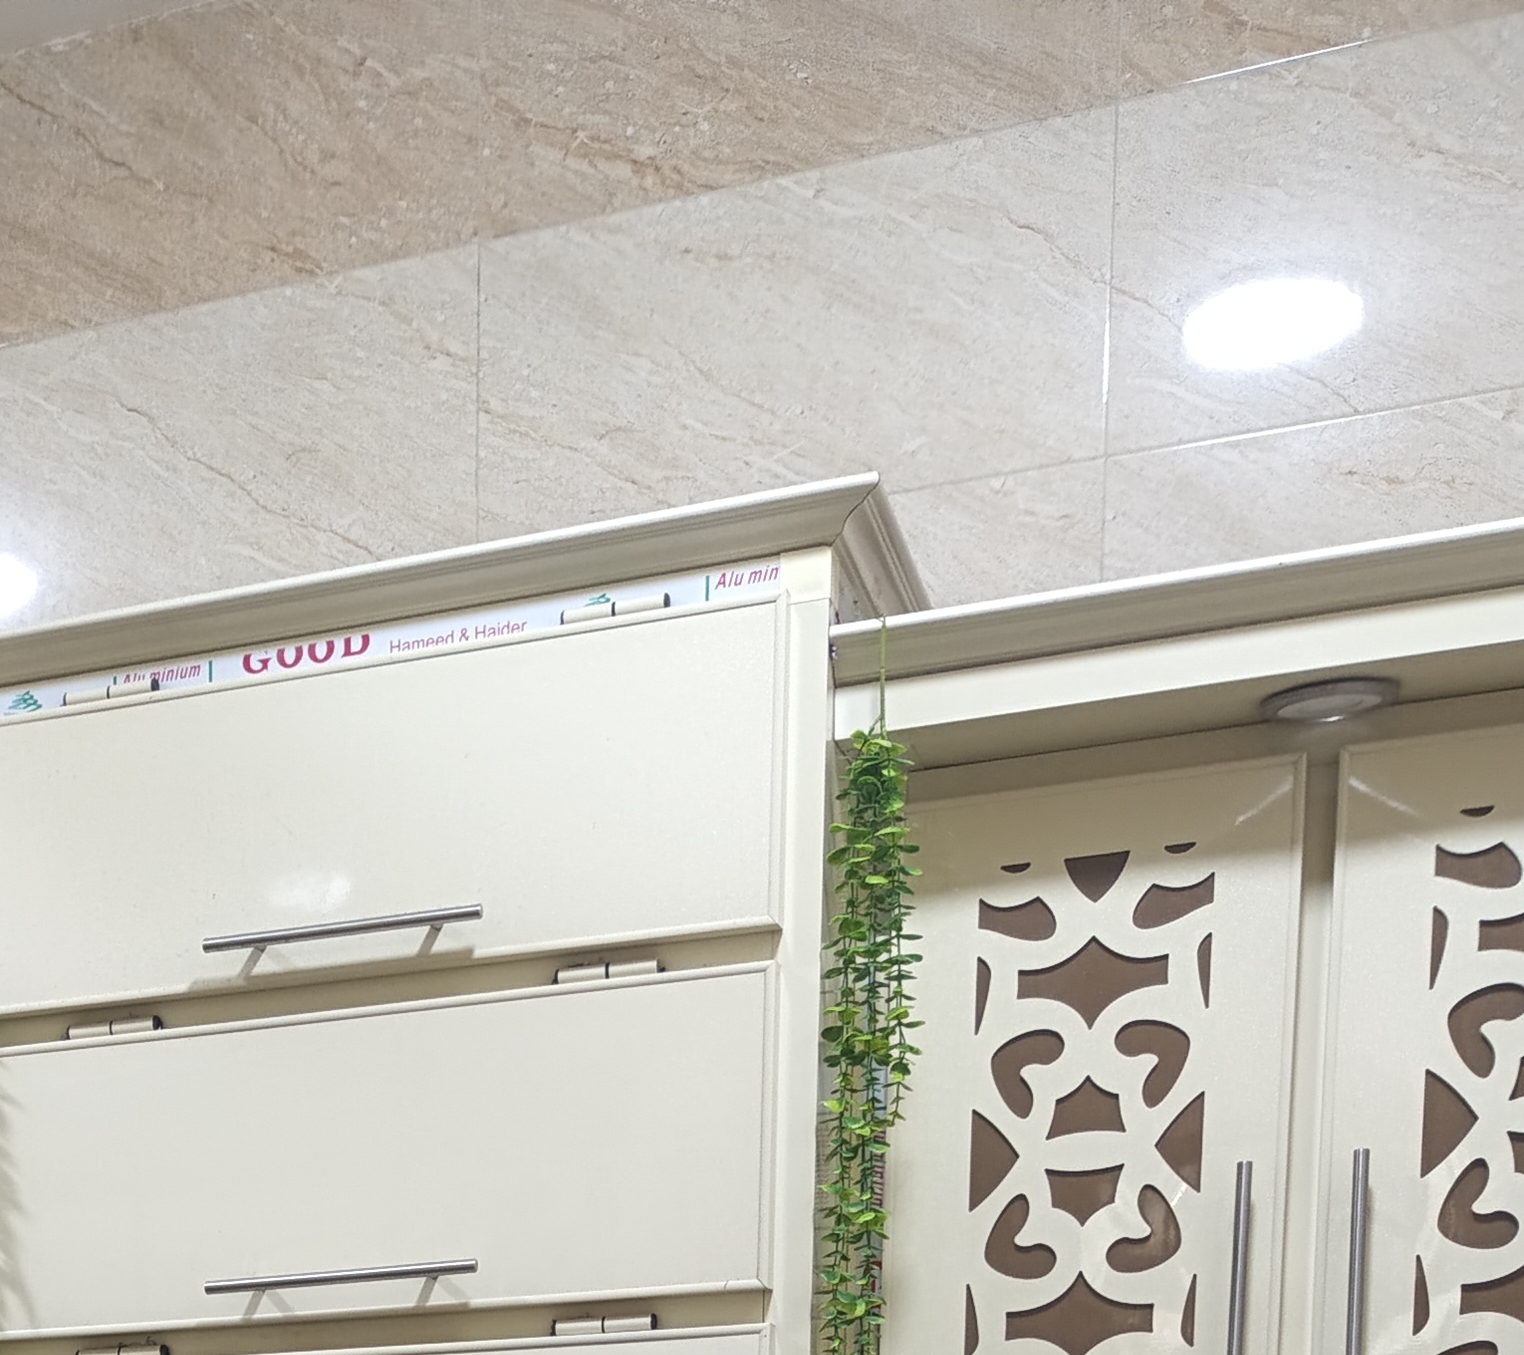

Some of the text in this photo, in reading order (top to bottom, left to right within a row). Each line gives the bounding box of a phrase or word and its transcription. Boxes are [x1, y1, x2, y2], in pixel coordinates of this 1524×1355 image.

[242, 633, 371, 674] GOOD
[389, 619, 528, 655] Hameed & Haider
